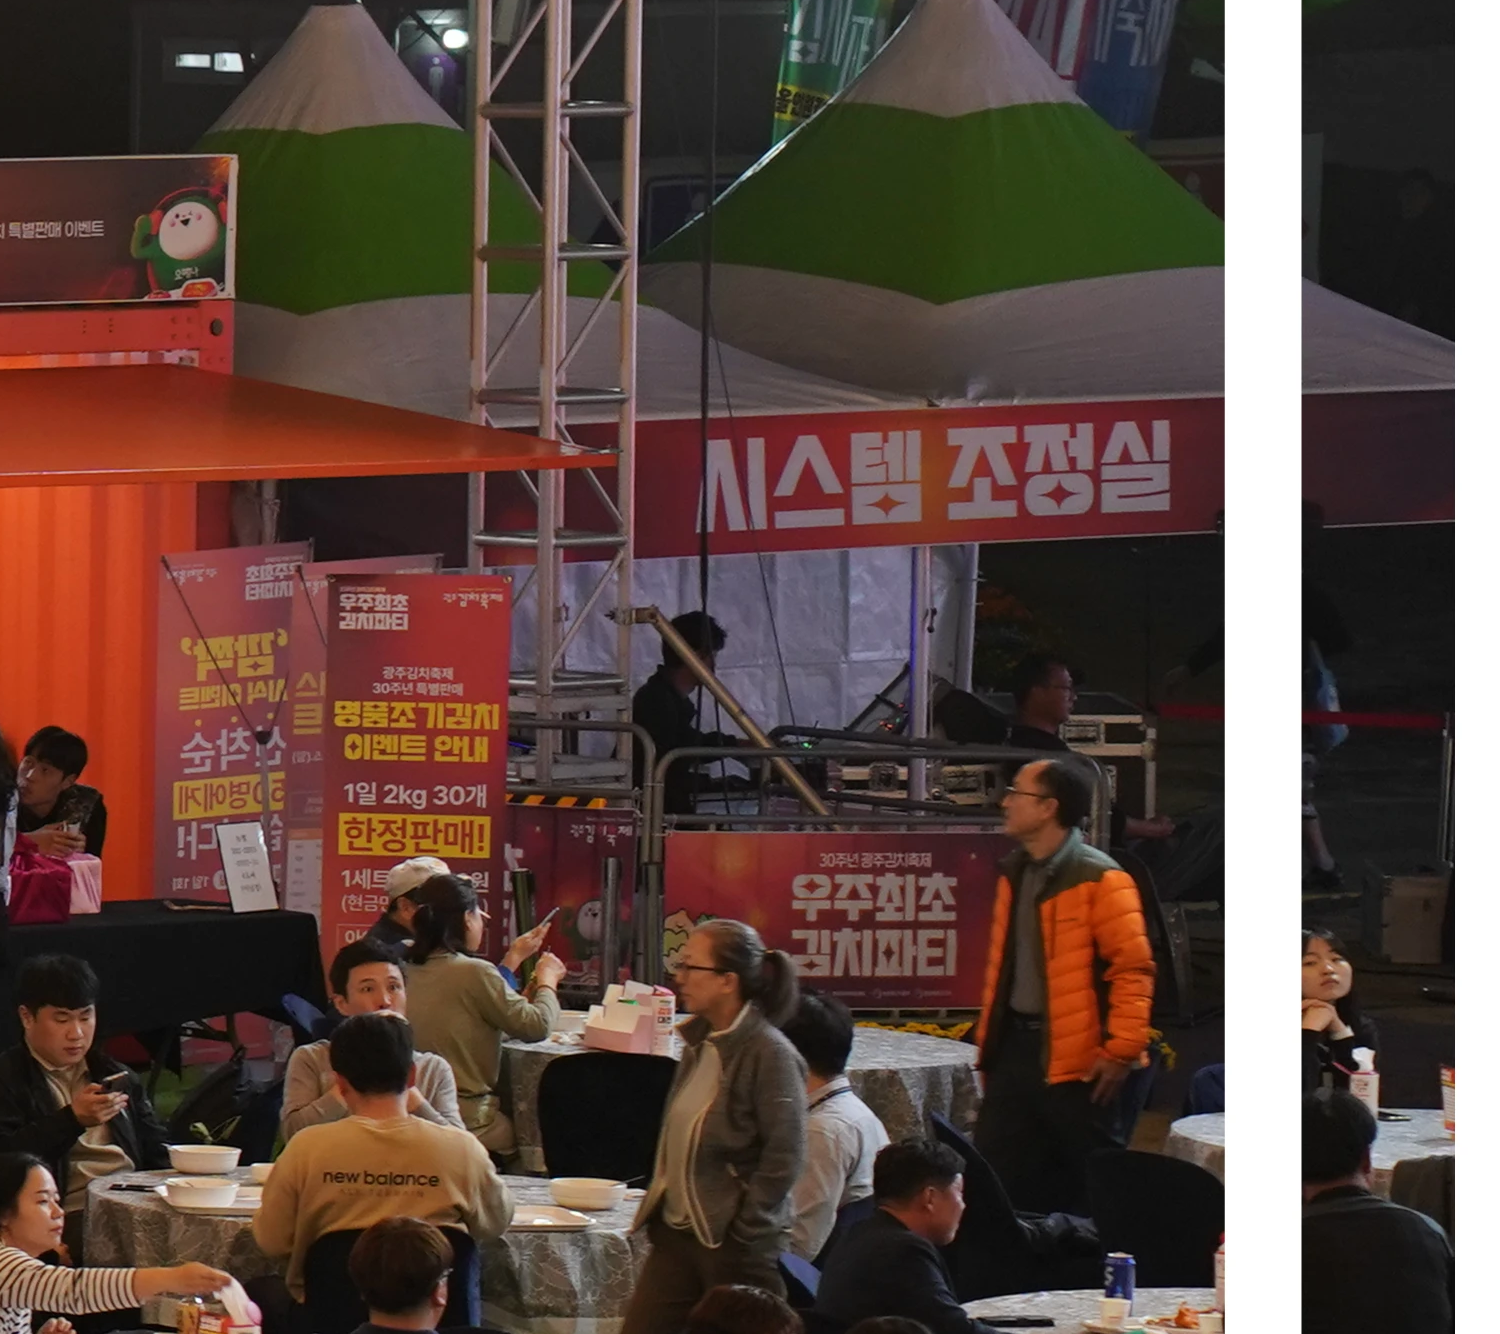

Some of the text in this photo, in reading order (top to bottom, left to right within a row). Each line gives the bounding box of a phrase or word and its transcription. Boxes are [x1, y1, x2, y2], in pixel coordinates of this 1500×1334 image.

[8, 220, 62, 239] 특별판매
[65, 219, 105, 238] 이벤트
[696, 419, 1172, 534] 시스템 조정실
[339, 593, 409, 612] 우주최초
[338, 612, 409, 631] 김치파티
[382, 666, 454, 680] 광주김치축제
[372, 682, 464, 697] 30주년 특별판매
[333, 700, 500, 731] 명품조기김치
[343, 734, 427, 762] 이벤트
[433, 735, 490, 763] 안내
[343, 782, 488, 809] 1일 2kg 30개
[343, 817, 485, 856] 한정판매!
[819, 852, 933, 868] 30주년 광주김치축제
[340, 868, 389, 890] 1세트
[791, 872, 958, 922] 우주최초
[790, 928, 958, 977] 김치파티
[323, 1169, 441, 1188] new balance
